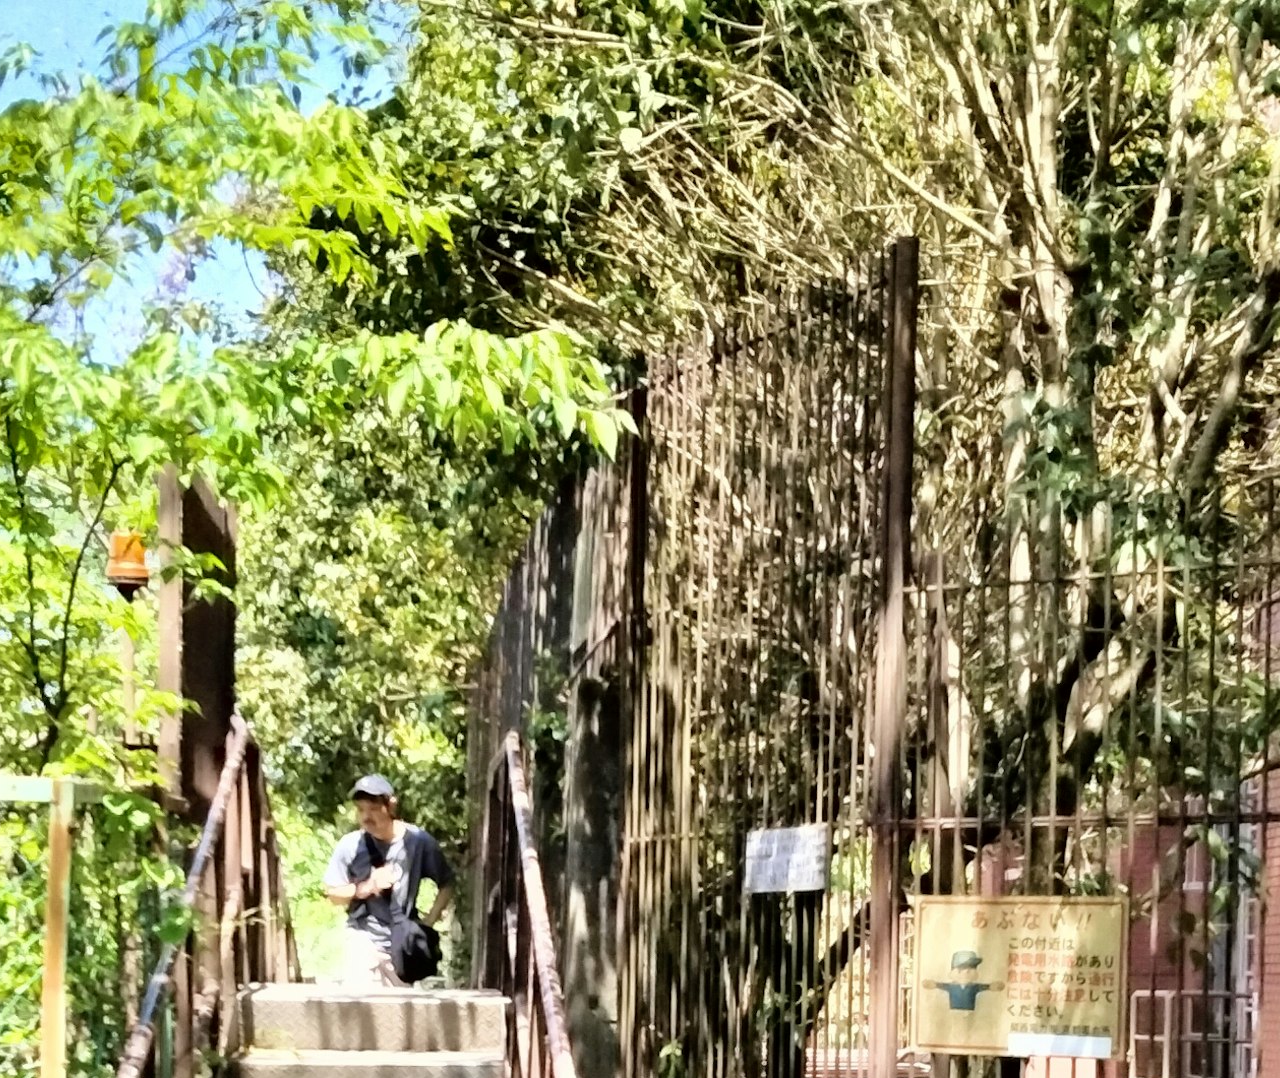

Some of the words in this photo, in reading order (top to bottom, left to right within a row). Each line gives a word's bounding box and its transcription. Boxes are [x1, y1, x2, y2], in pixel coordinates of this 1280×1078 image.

[1008, 936, 1075, 951] この付近は
[1007, 1003, 1064, 1020] ください。
